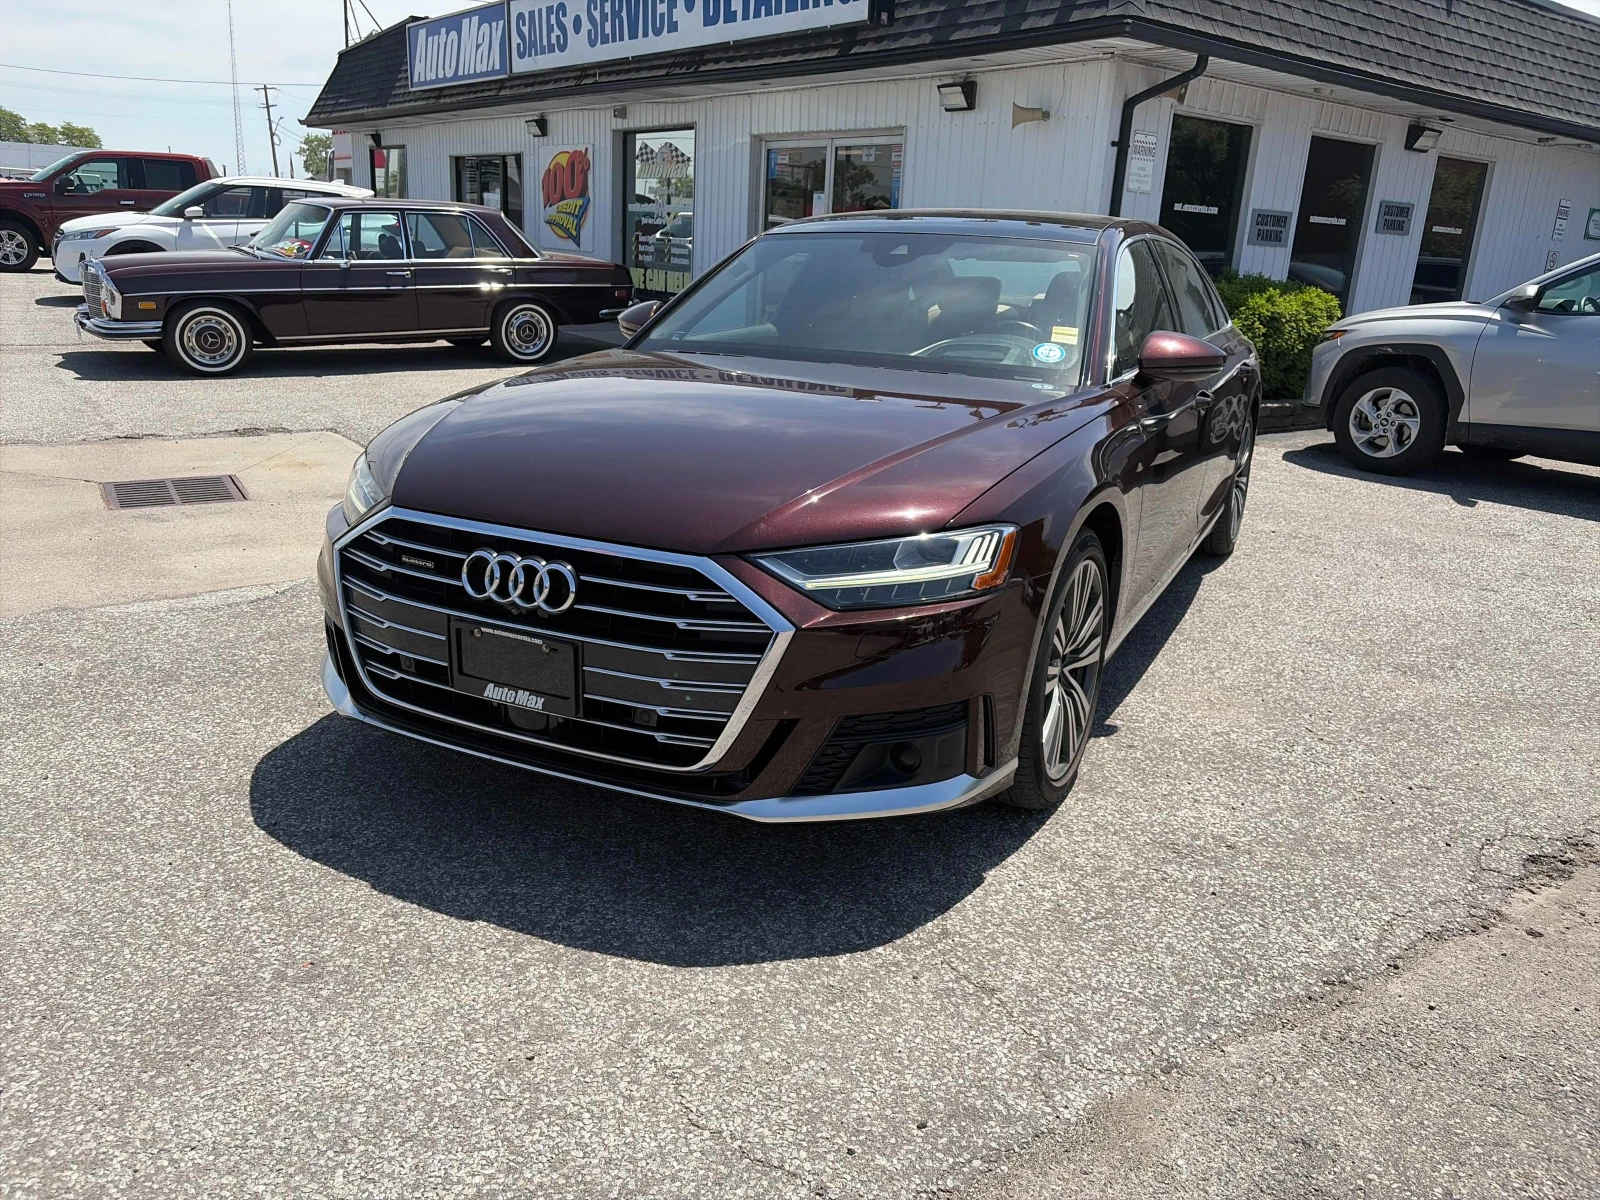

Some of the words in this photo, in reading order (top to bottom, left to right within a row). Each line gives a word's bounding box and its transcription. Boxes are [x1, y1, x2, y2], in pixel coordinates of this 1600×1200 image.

[516, 1, 569, 60] SALES
[586, 0, 679, 49] SERVICE
[1133, 144, 1156, 158] WARNING
[541, 146, 591, 208] 100%
[556, 199, 584, 216] CREDIT
[1384, 204, 1410, 218] CUSTOMER
[1256, 213, 1288, 228] CUSTOMER
[1383, 219, 1405, 231] PARKING
[1256, 228, 1283, 243] PARKING
[629, 267, 645, 290] WE
[646, 268, 666, 292] CAN
